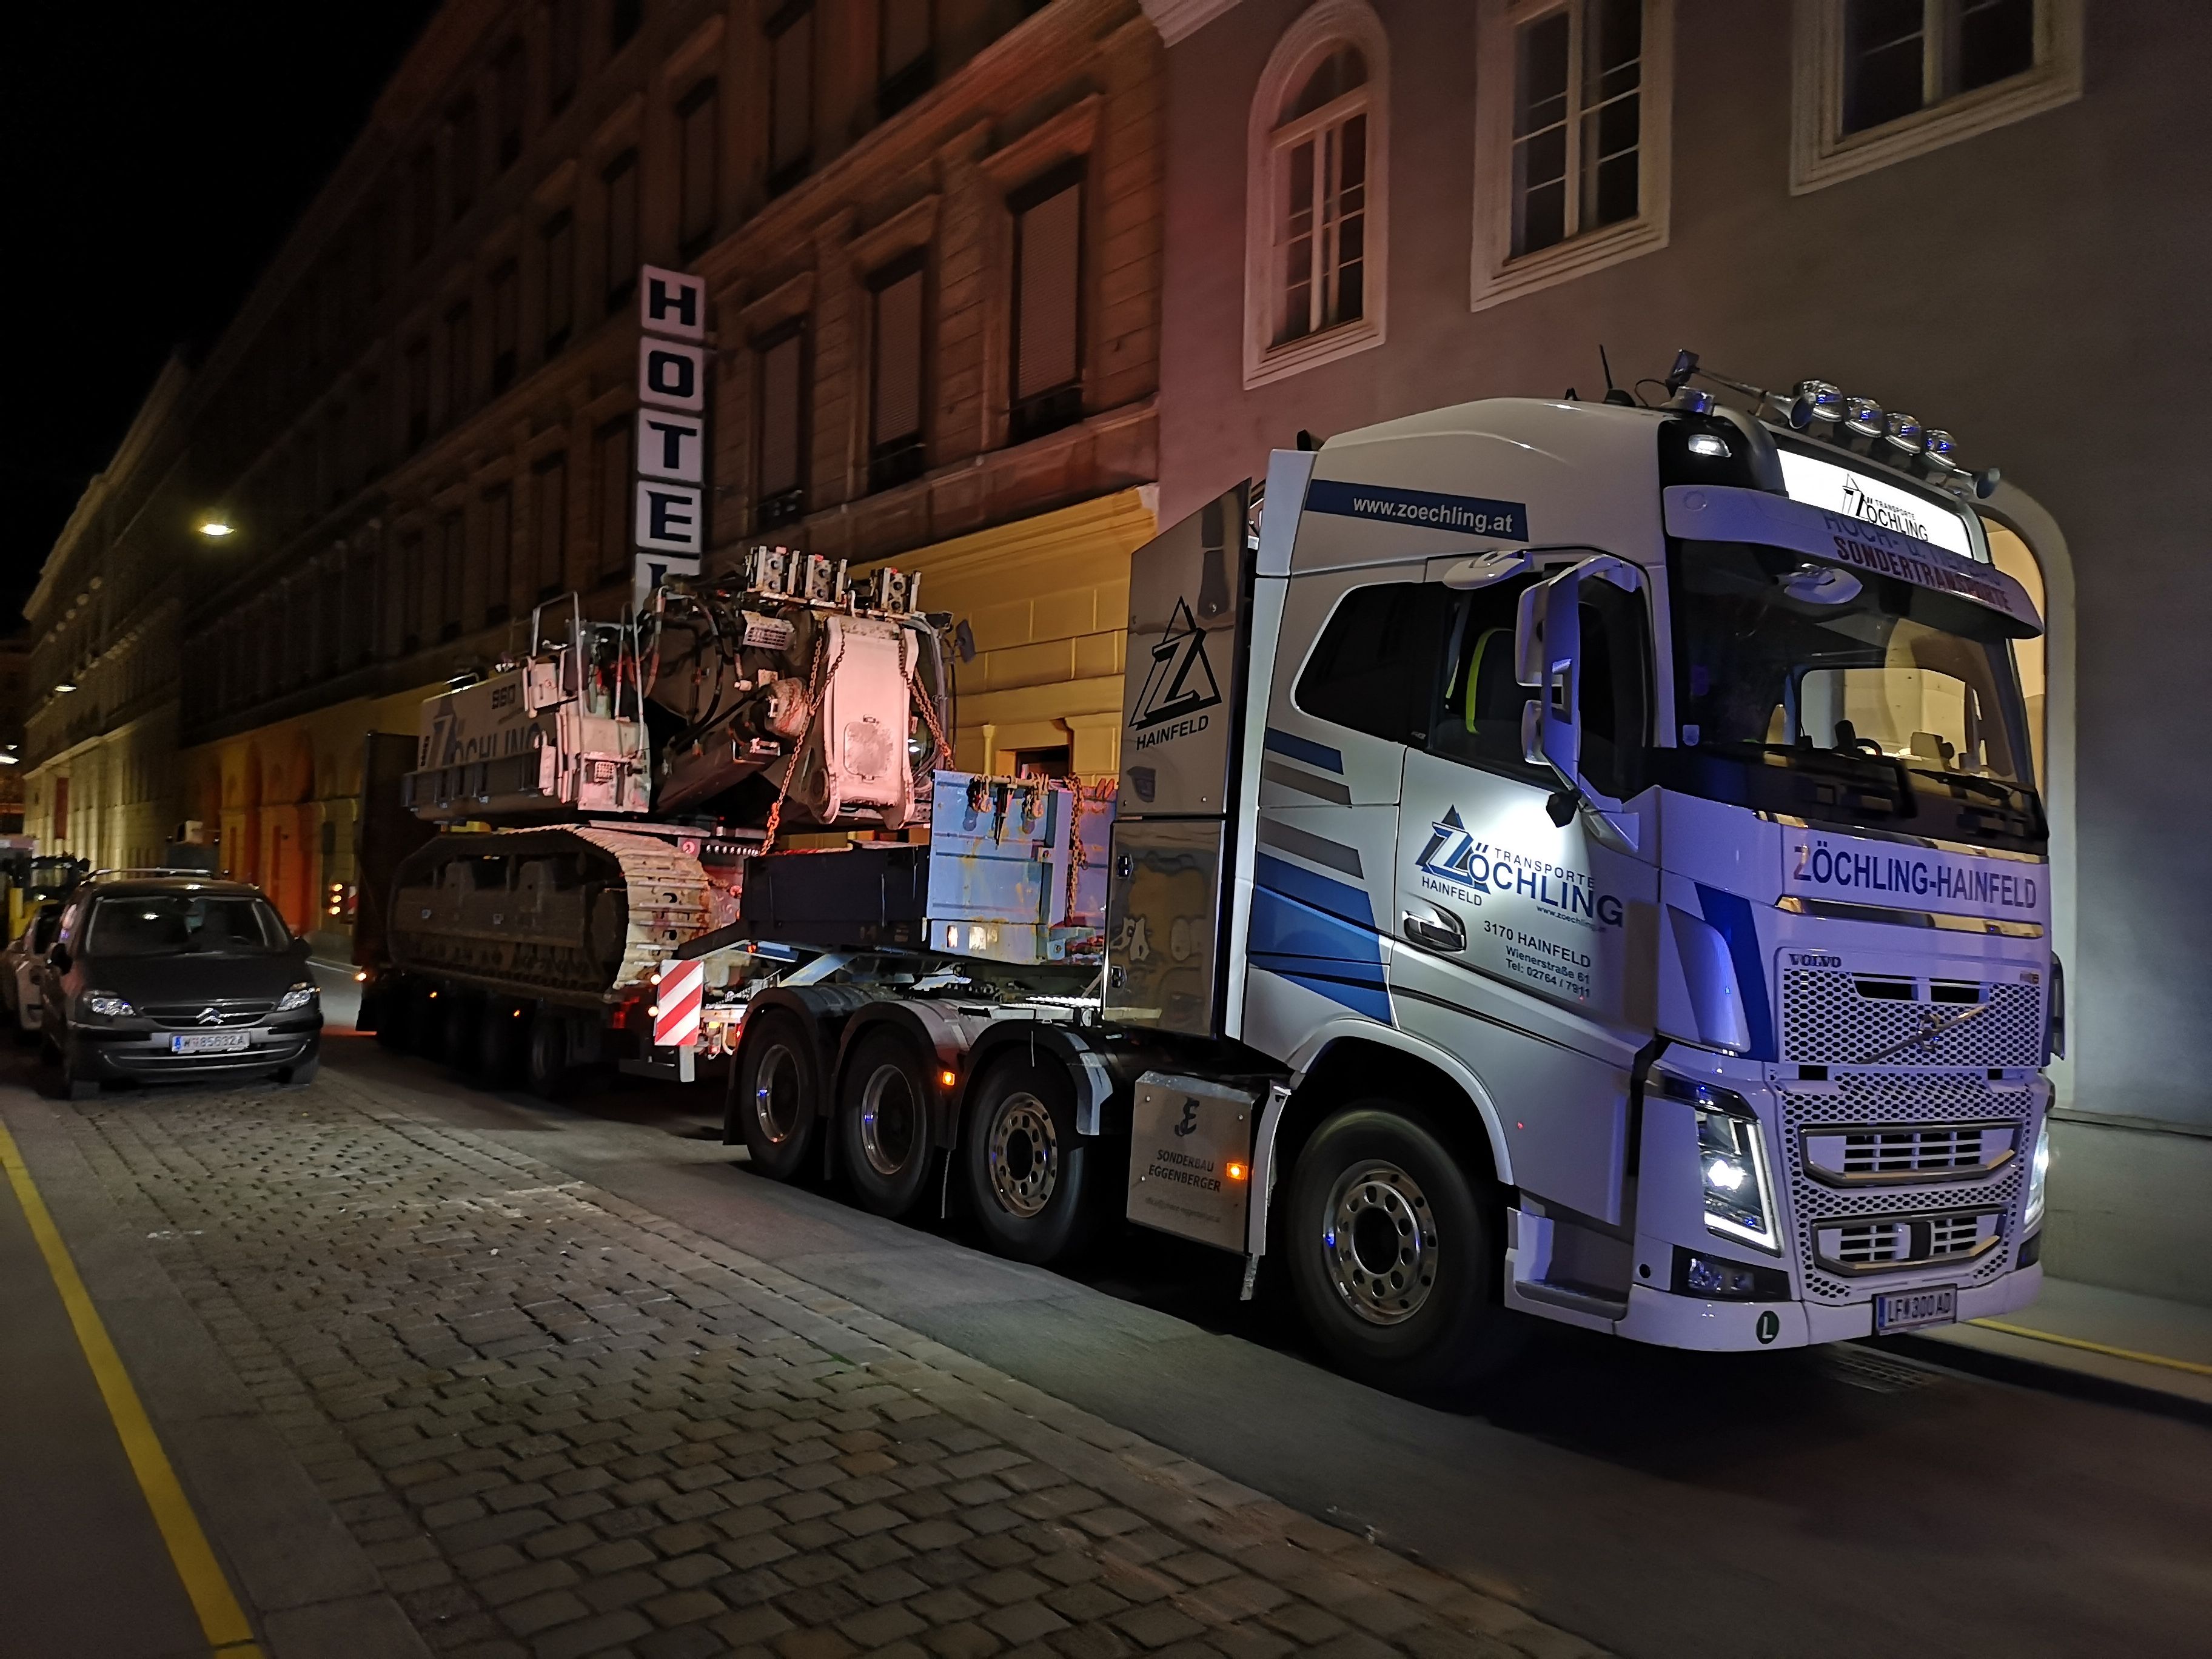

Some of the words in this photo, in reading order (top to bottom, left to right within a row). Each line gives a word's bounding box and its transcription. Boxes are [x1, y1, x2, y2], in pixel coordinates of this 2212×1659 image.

[1353, 497, 1512, 534] www.zoechling.at
[1874, 499, 1915, 520] TRANSPORTE
[1136, 715, 1208, 751] HAINFELD
[1495, 848, 1595, 889] TRANSPORTE
[1793, 840, 2037, 909] ZÖCHLING-HAINFELD
[1422, 876, 1483, 907] HAINFELD
[1484, 920, 1513, 940] 3170
[1518, 932, 1591, 968] HAINFELD
[1506, 945, 1575, 979] Wienerstraße
[1577, 972, 1590, 985] 61
[1506, 958, 1524, 973] Tel:
[1526, 967, 1557, 985] 02764
[1788, 953, 1842, 968] VOLVO
[1156, 1149, 1215, 1172] SONDERBAU
[1148, 1164, 1221, 1193] EGGENBERGER
[1762, 1316, 1773, 1339] L
